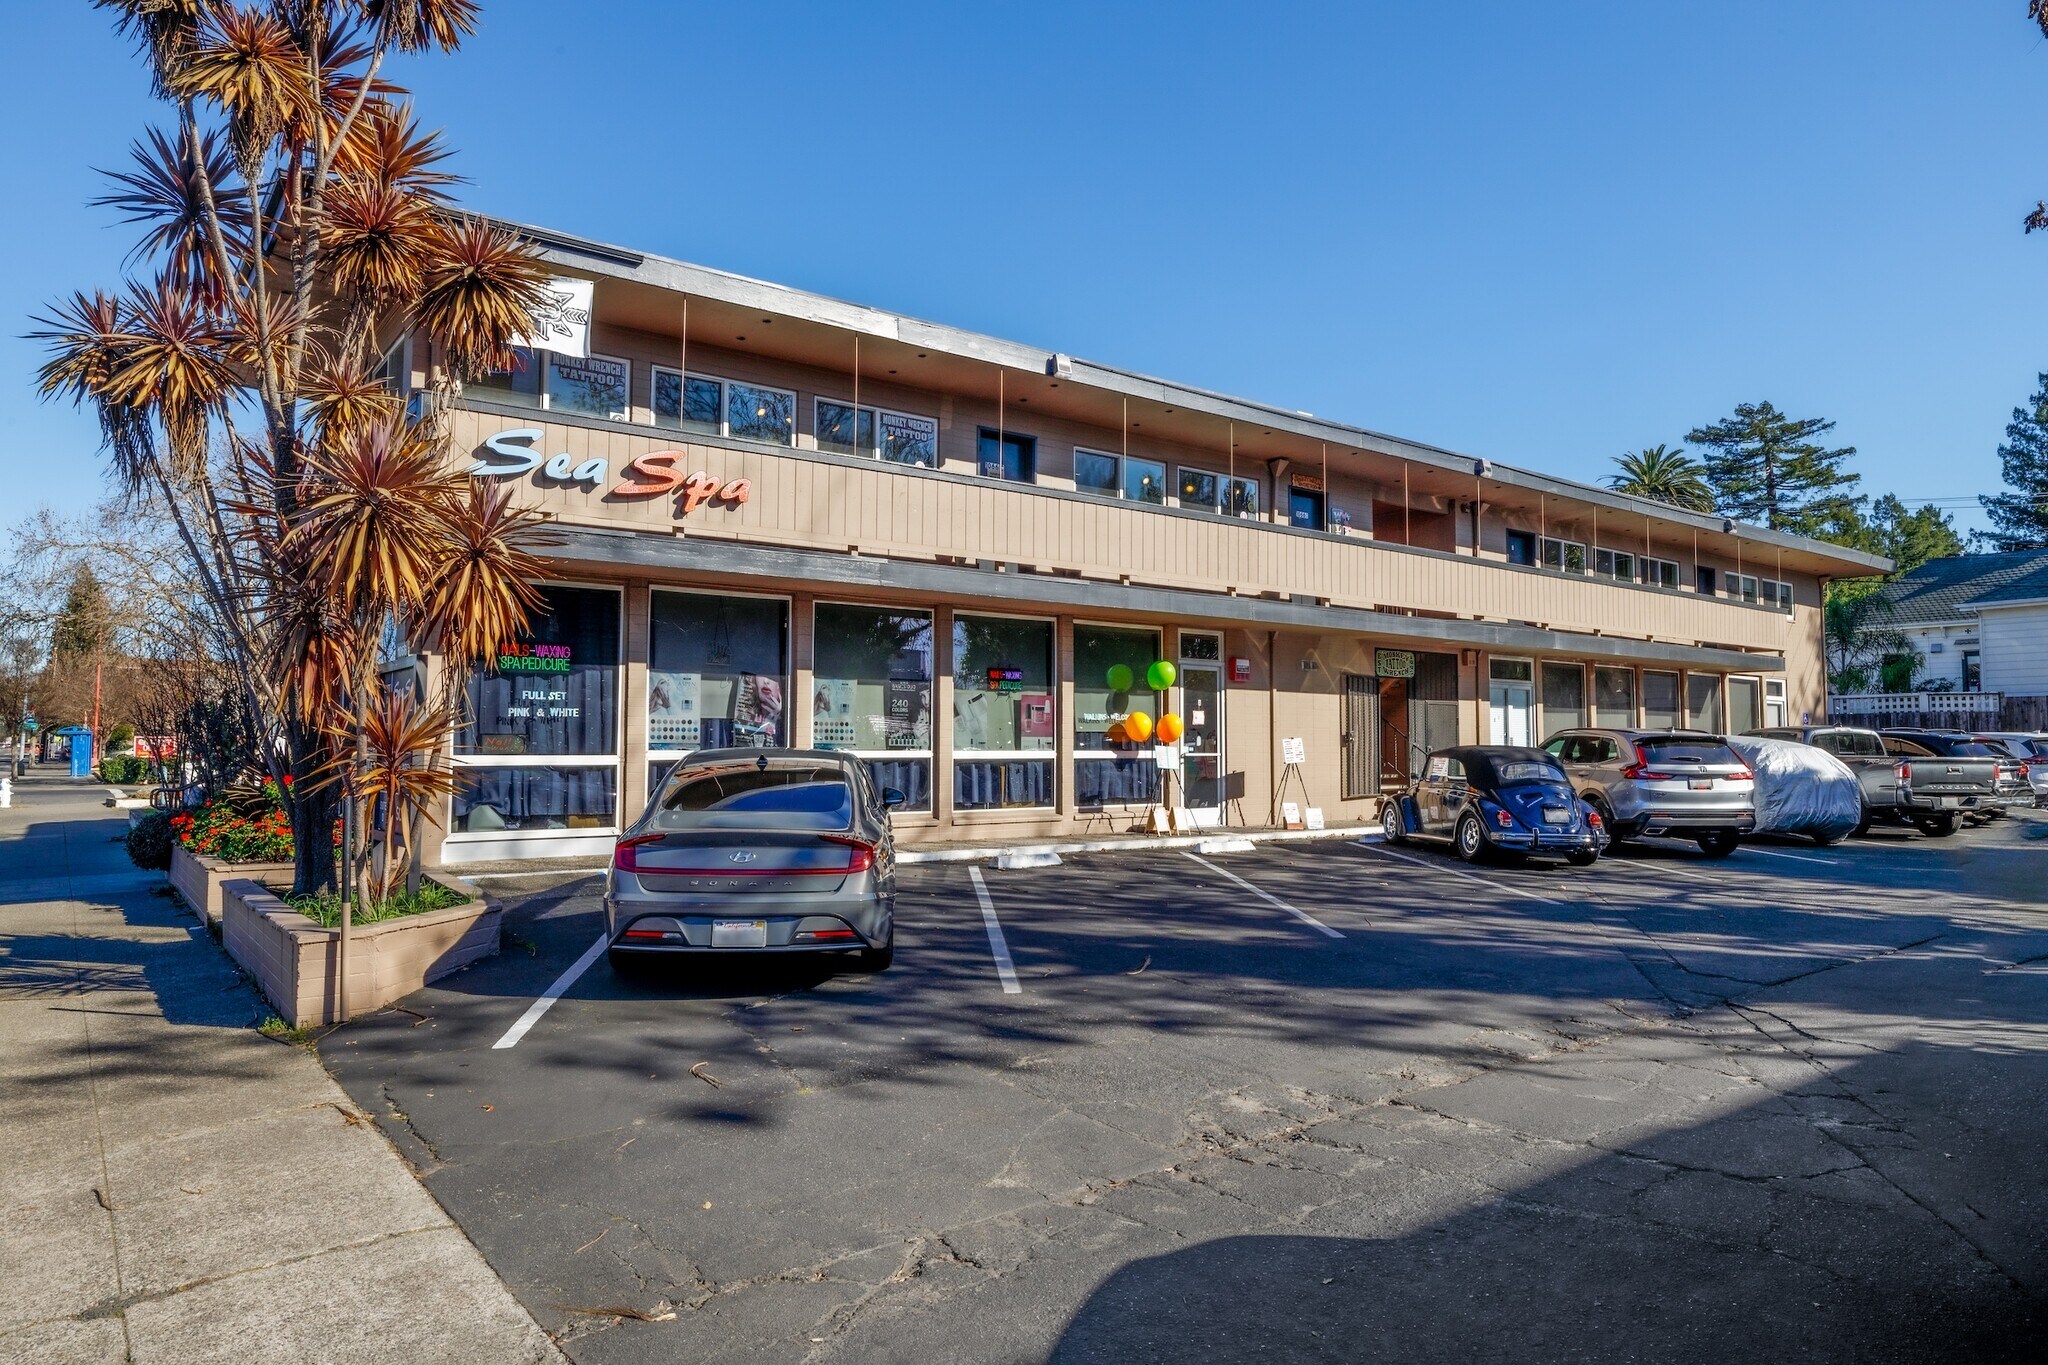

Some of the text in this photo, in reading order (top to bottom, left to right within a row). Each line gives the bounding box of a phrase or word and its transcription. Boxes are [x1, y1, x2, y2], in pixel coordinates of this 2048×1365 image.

[552, 353, 621, 374] MONKEY WRENCH
[560, 367, 615, 385] TATTOO
[882, 414, 932, 433] MONKEY WRENCH
[888, 426, 928, 441] TATTOO
[464, 428, 752, 512] Sea Spa
[500, 656, 571, 671] SPA PEDICURE
[1385, 658, 1407, 669] TATTOO
[522, 690, 567, 700] FULL SET
[892, 699, 909, 708] 240
[508, 708, 579, 717] PINK & WHITE
